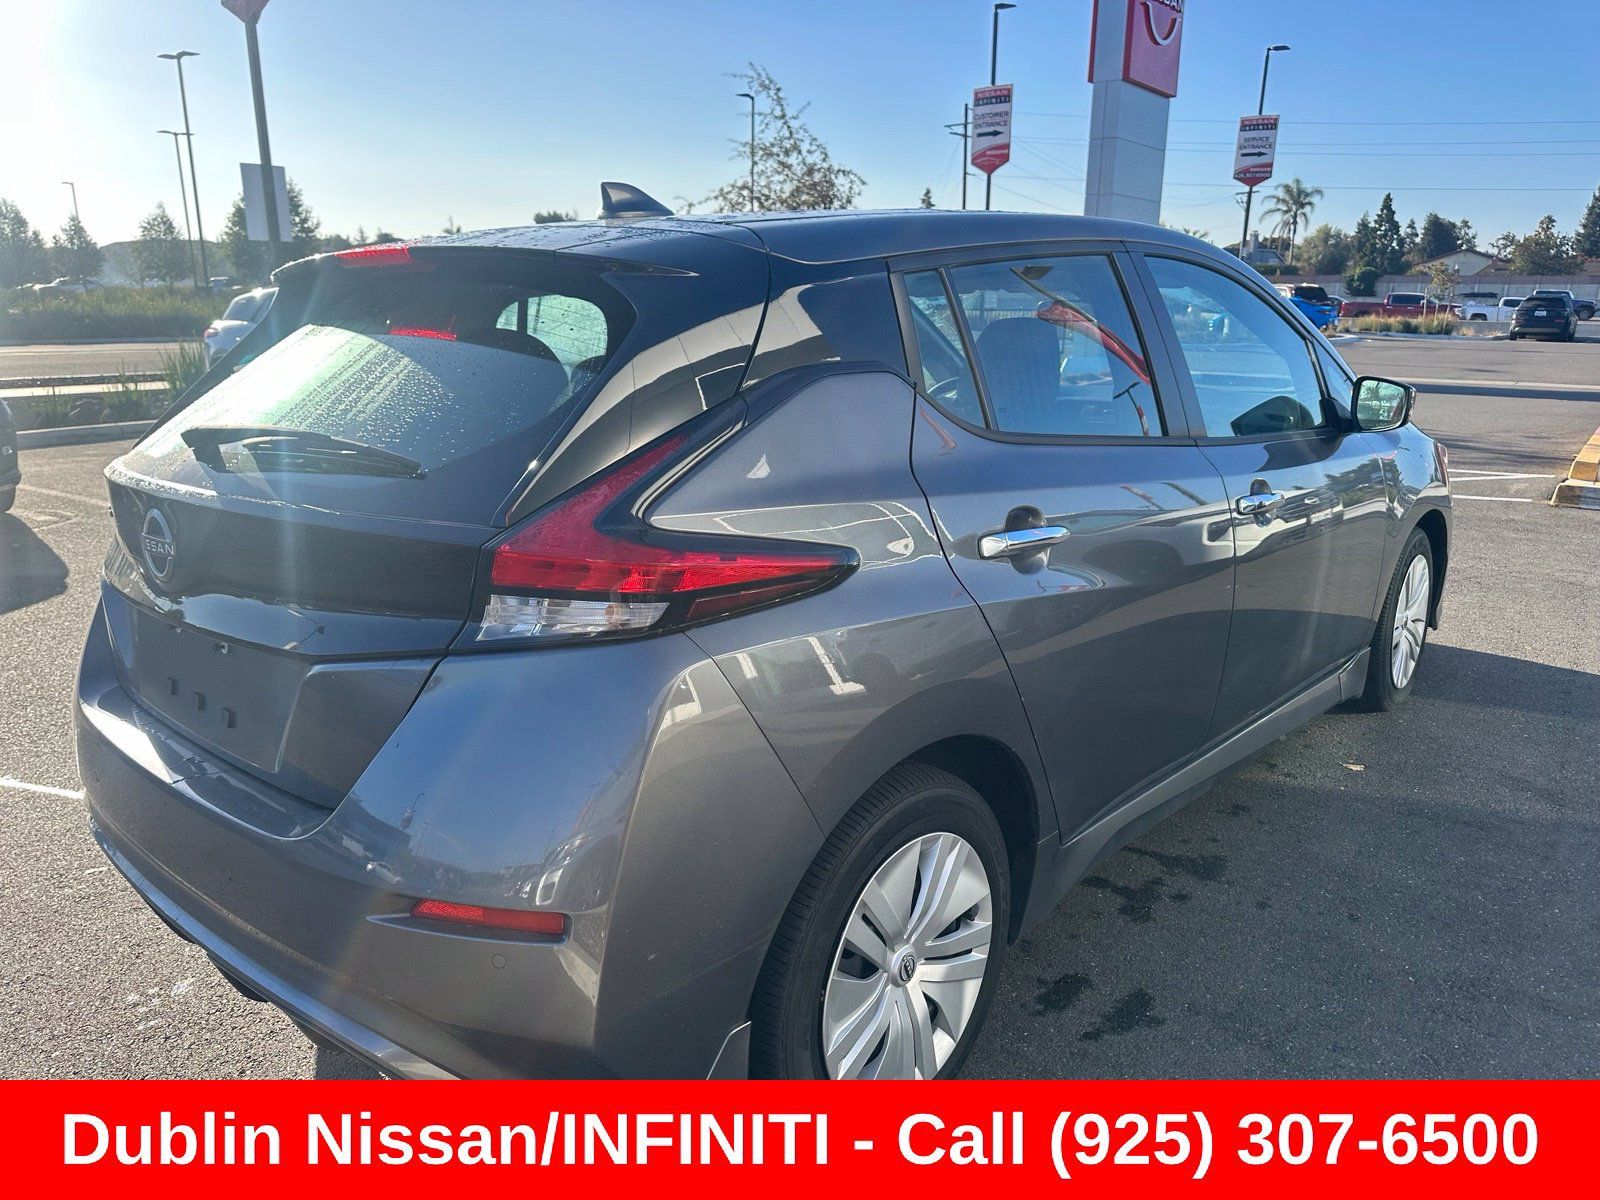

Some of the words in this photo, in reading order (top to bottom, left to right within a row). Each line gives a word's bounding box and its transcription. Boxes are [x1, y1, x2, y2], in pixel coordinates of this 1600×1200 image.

[976, 89, 1008, 98] NISSAN
[974, 111, 1009, 120] CUSTOMER
[974, 120, 1008, 129] ENTRANCE
[145, 539, 175, 556] SSAN
